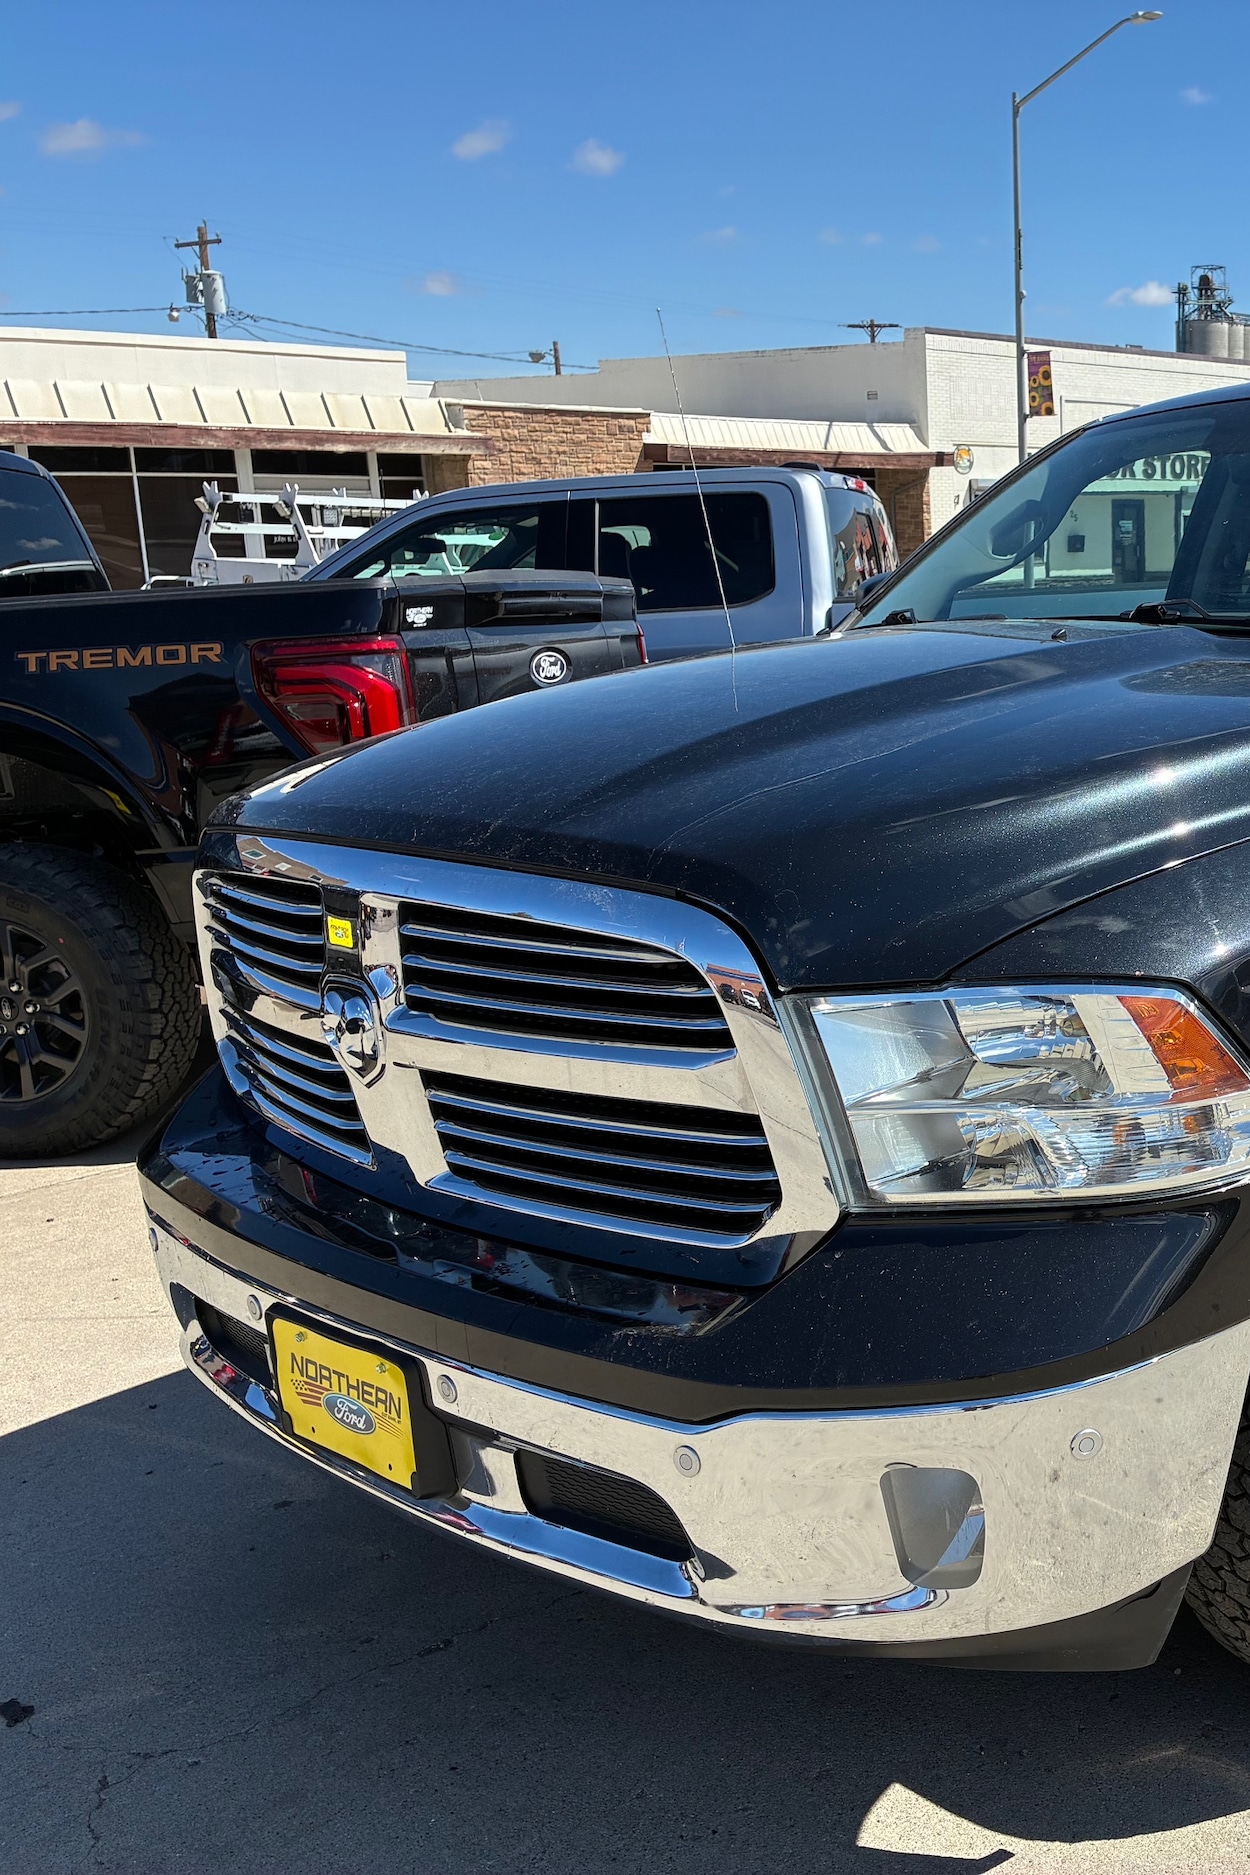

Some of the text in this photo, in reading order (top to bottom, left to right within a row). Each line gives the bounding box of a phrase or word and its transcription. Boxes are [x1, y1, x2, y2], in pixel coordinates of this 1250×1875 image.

[16, 642, 223, 672] TREMOR
[540, 655, 562, 678] Ford
[290, 1352, 402, 1420] NORTHERN
[334, 1397, 367, 1430] Ford
